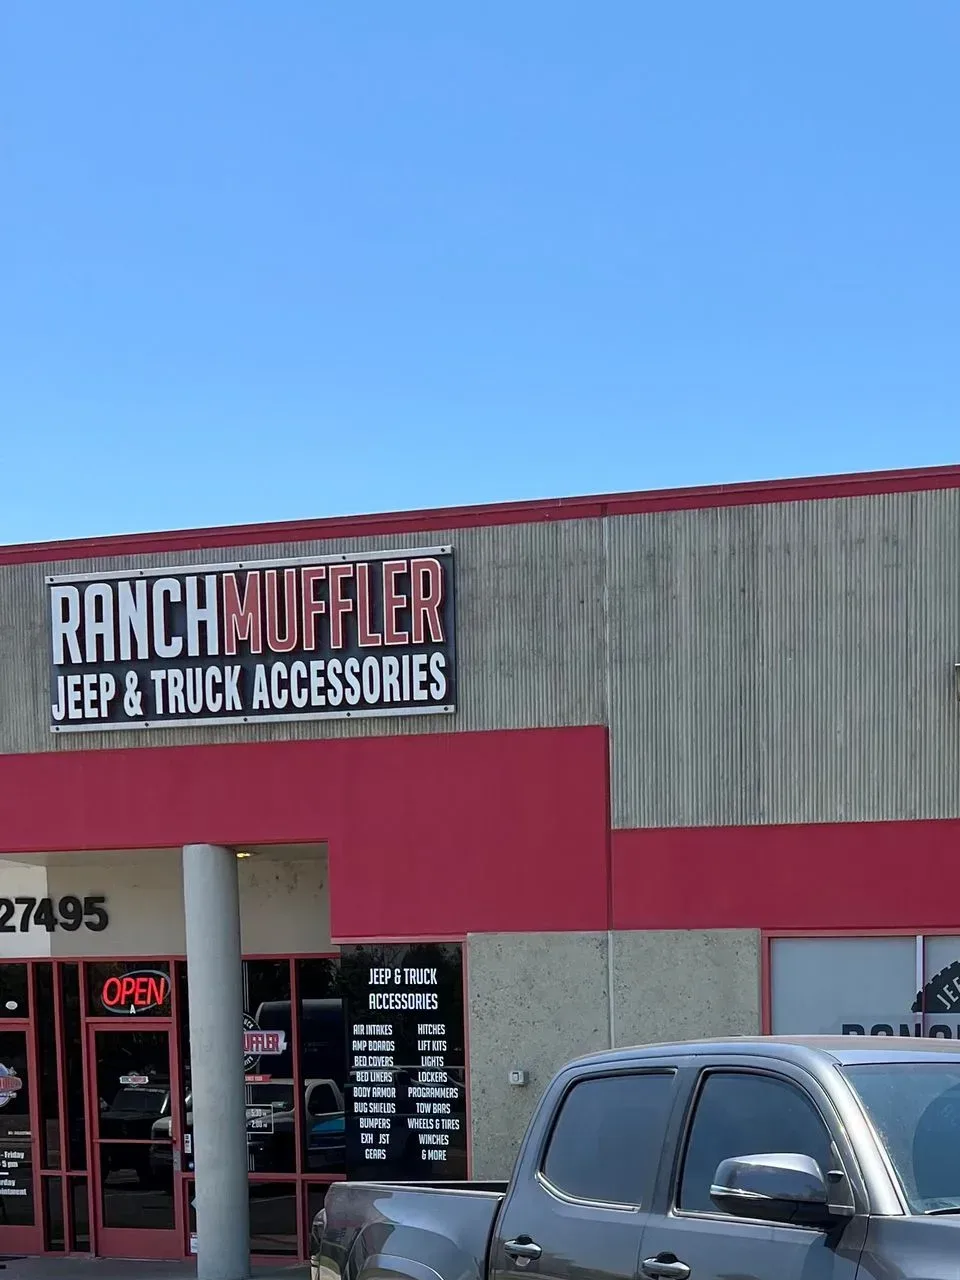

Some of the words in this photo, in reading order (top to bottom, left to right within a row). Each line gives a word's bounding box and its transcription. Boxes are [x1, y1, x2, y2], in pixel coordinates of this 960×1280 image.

[52, 673, 116, 721] JEEP
[124, 670, 144, 716] &
[151, 665, 242, 714] TRUCK
[252, 651, 447, 710] ACCESSORIES
[0, 896, 109, 932] 27495
[368, 968, 391, 985] JEEP
[394, 968, 401, 985] &
[403, 968, 438, 985] TRUCK
[102, 977, 165, 1005] OPEN
[368, 993, 438, 1010] ACCESSORIES
[353, 1024, 365, 1035] AIR
[366, 1024, 393, 1036] INTAKES
[417, 1024, 446, 1035] HITCHES
[368, 1040, 395, 1051] BOARDS
[417, 1040, 431, 1051] LIFT
[432, 1040, 447, 1051] KITS
[354, 1056, 367, 1066] BED
[368, 1056, 394, 1067] COVERS
[421, 1056, 444, 1067] LIGHTS
[356, 1072, 369, 1082] BED
[370, 1072, 393, 1083] LINERS
[418, 1072, 448, 1083] LOCKERS
[353, 1087, 371, 1098] BODY
[372, 1087, 396, 1098] ARMOR
[407, 1087, 459, 1098] PROGRAMMERS
[354, 1102, 368, 1113] BUG
[369, 1102, 396, 1113] SHIELDS
[416, 1103, 431, 1114] TOW
[432, 1103, 451, 1114] BARS
[359, 1118, 391, 1129] BUMPERS
[407, 1118, 434, 1129] WHEELS
[435, 1119, 440, 1129] &
[441, 1119, 460, 1130] TIRES
[361, 1133, 390, 1144] EXHST
[418, 1134, 449, 1145] WINCHES
[4, 1151, 25, 1159] Friday
[365, 1149, 387, 1160] GEARS
[421, 1150, 427, 1160] &
[428, 1150, 447, 1160] MORE
[0, 1179, 16, 1187] rday
